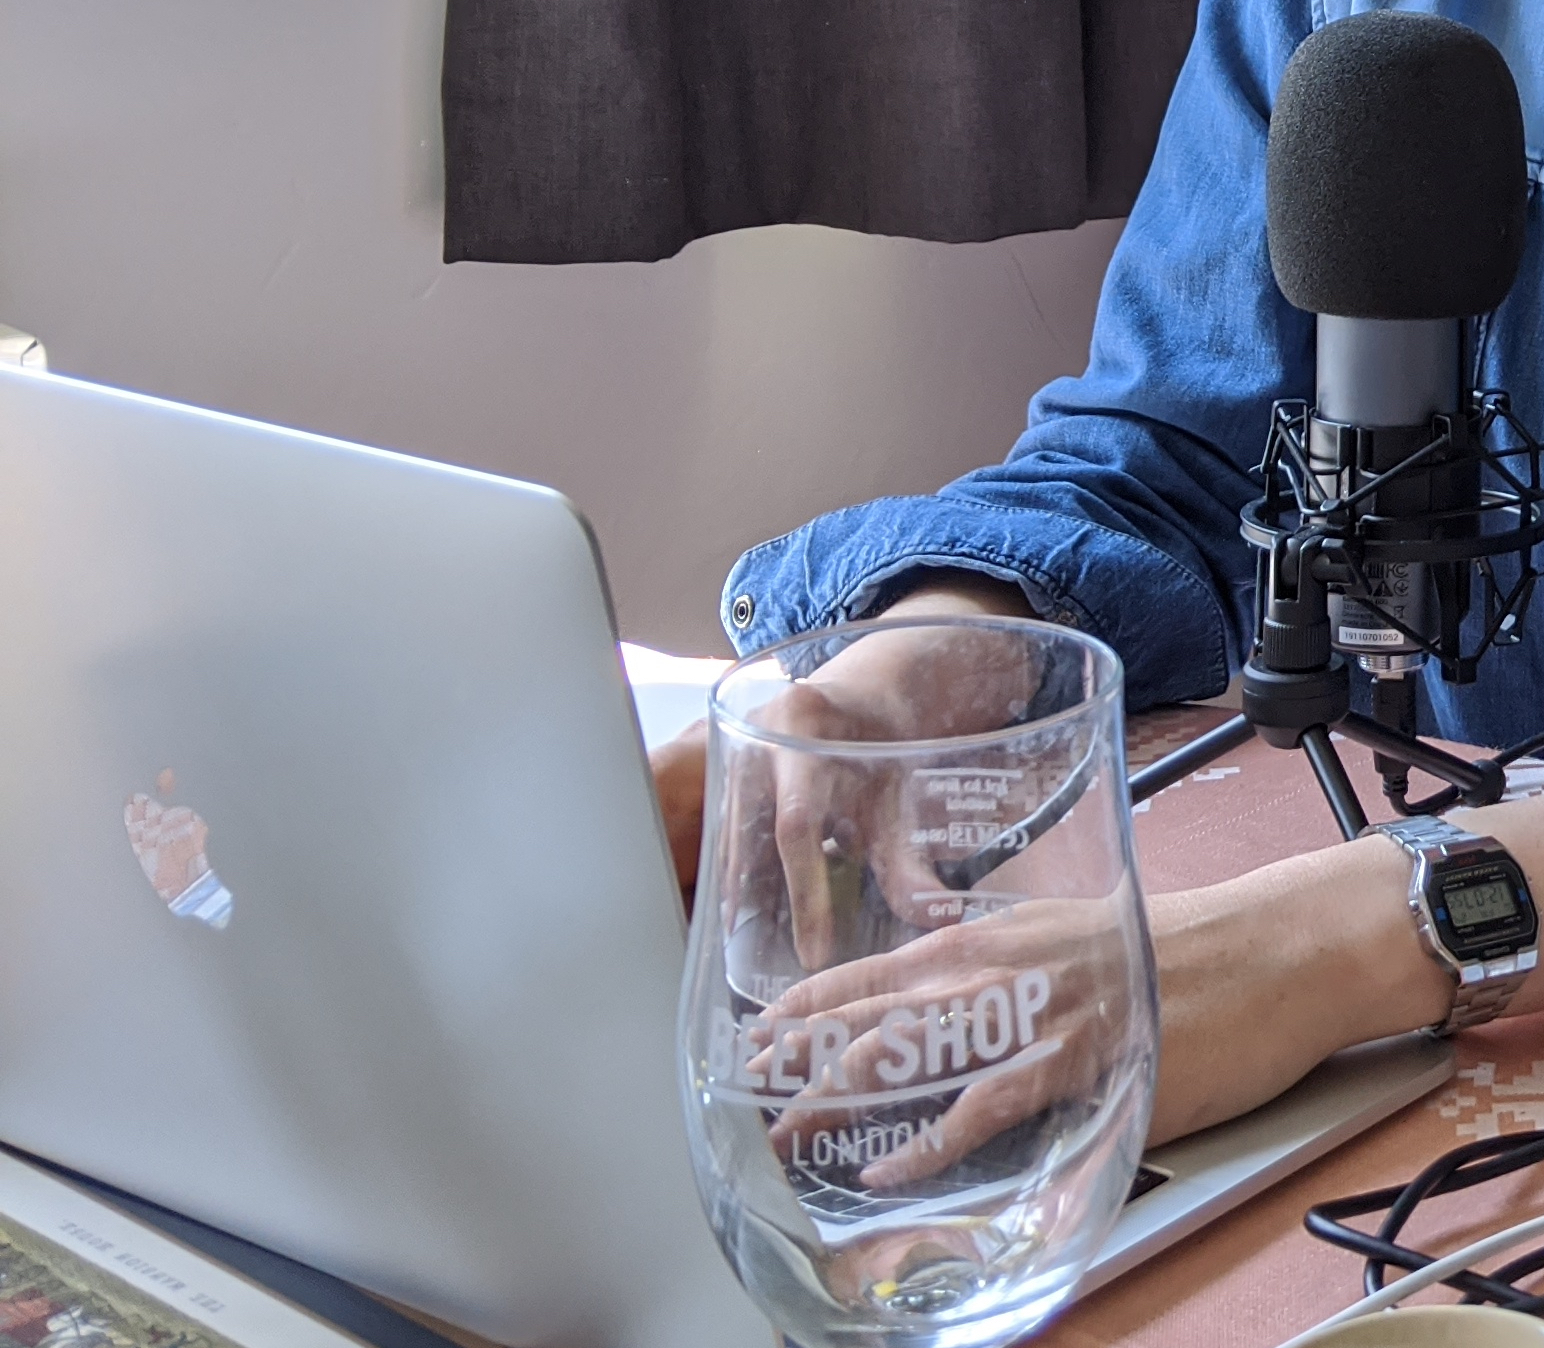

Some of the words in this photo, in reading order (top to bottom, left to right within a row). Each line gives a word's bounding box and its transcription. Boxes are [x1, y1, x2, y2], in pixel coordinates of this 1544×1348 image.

[751, 974, 791, 1000] THE
[707, 1006, 851, 1091] BEER
[876, 968, 1051, 1085] SHOP
[792, 1114, 944, 1167] LONDON
